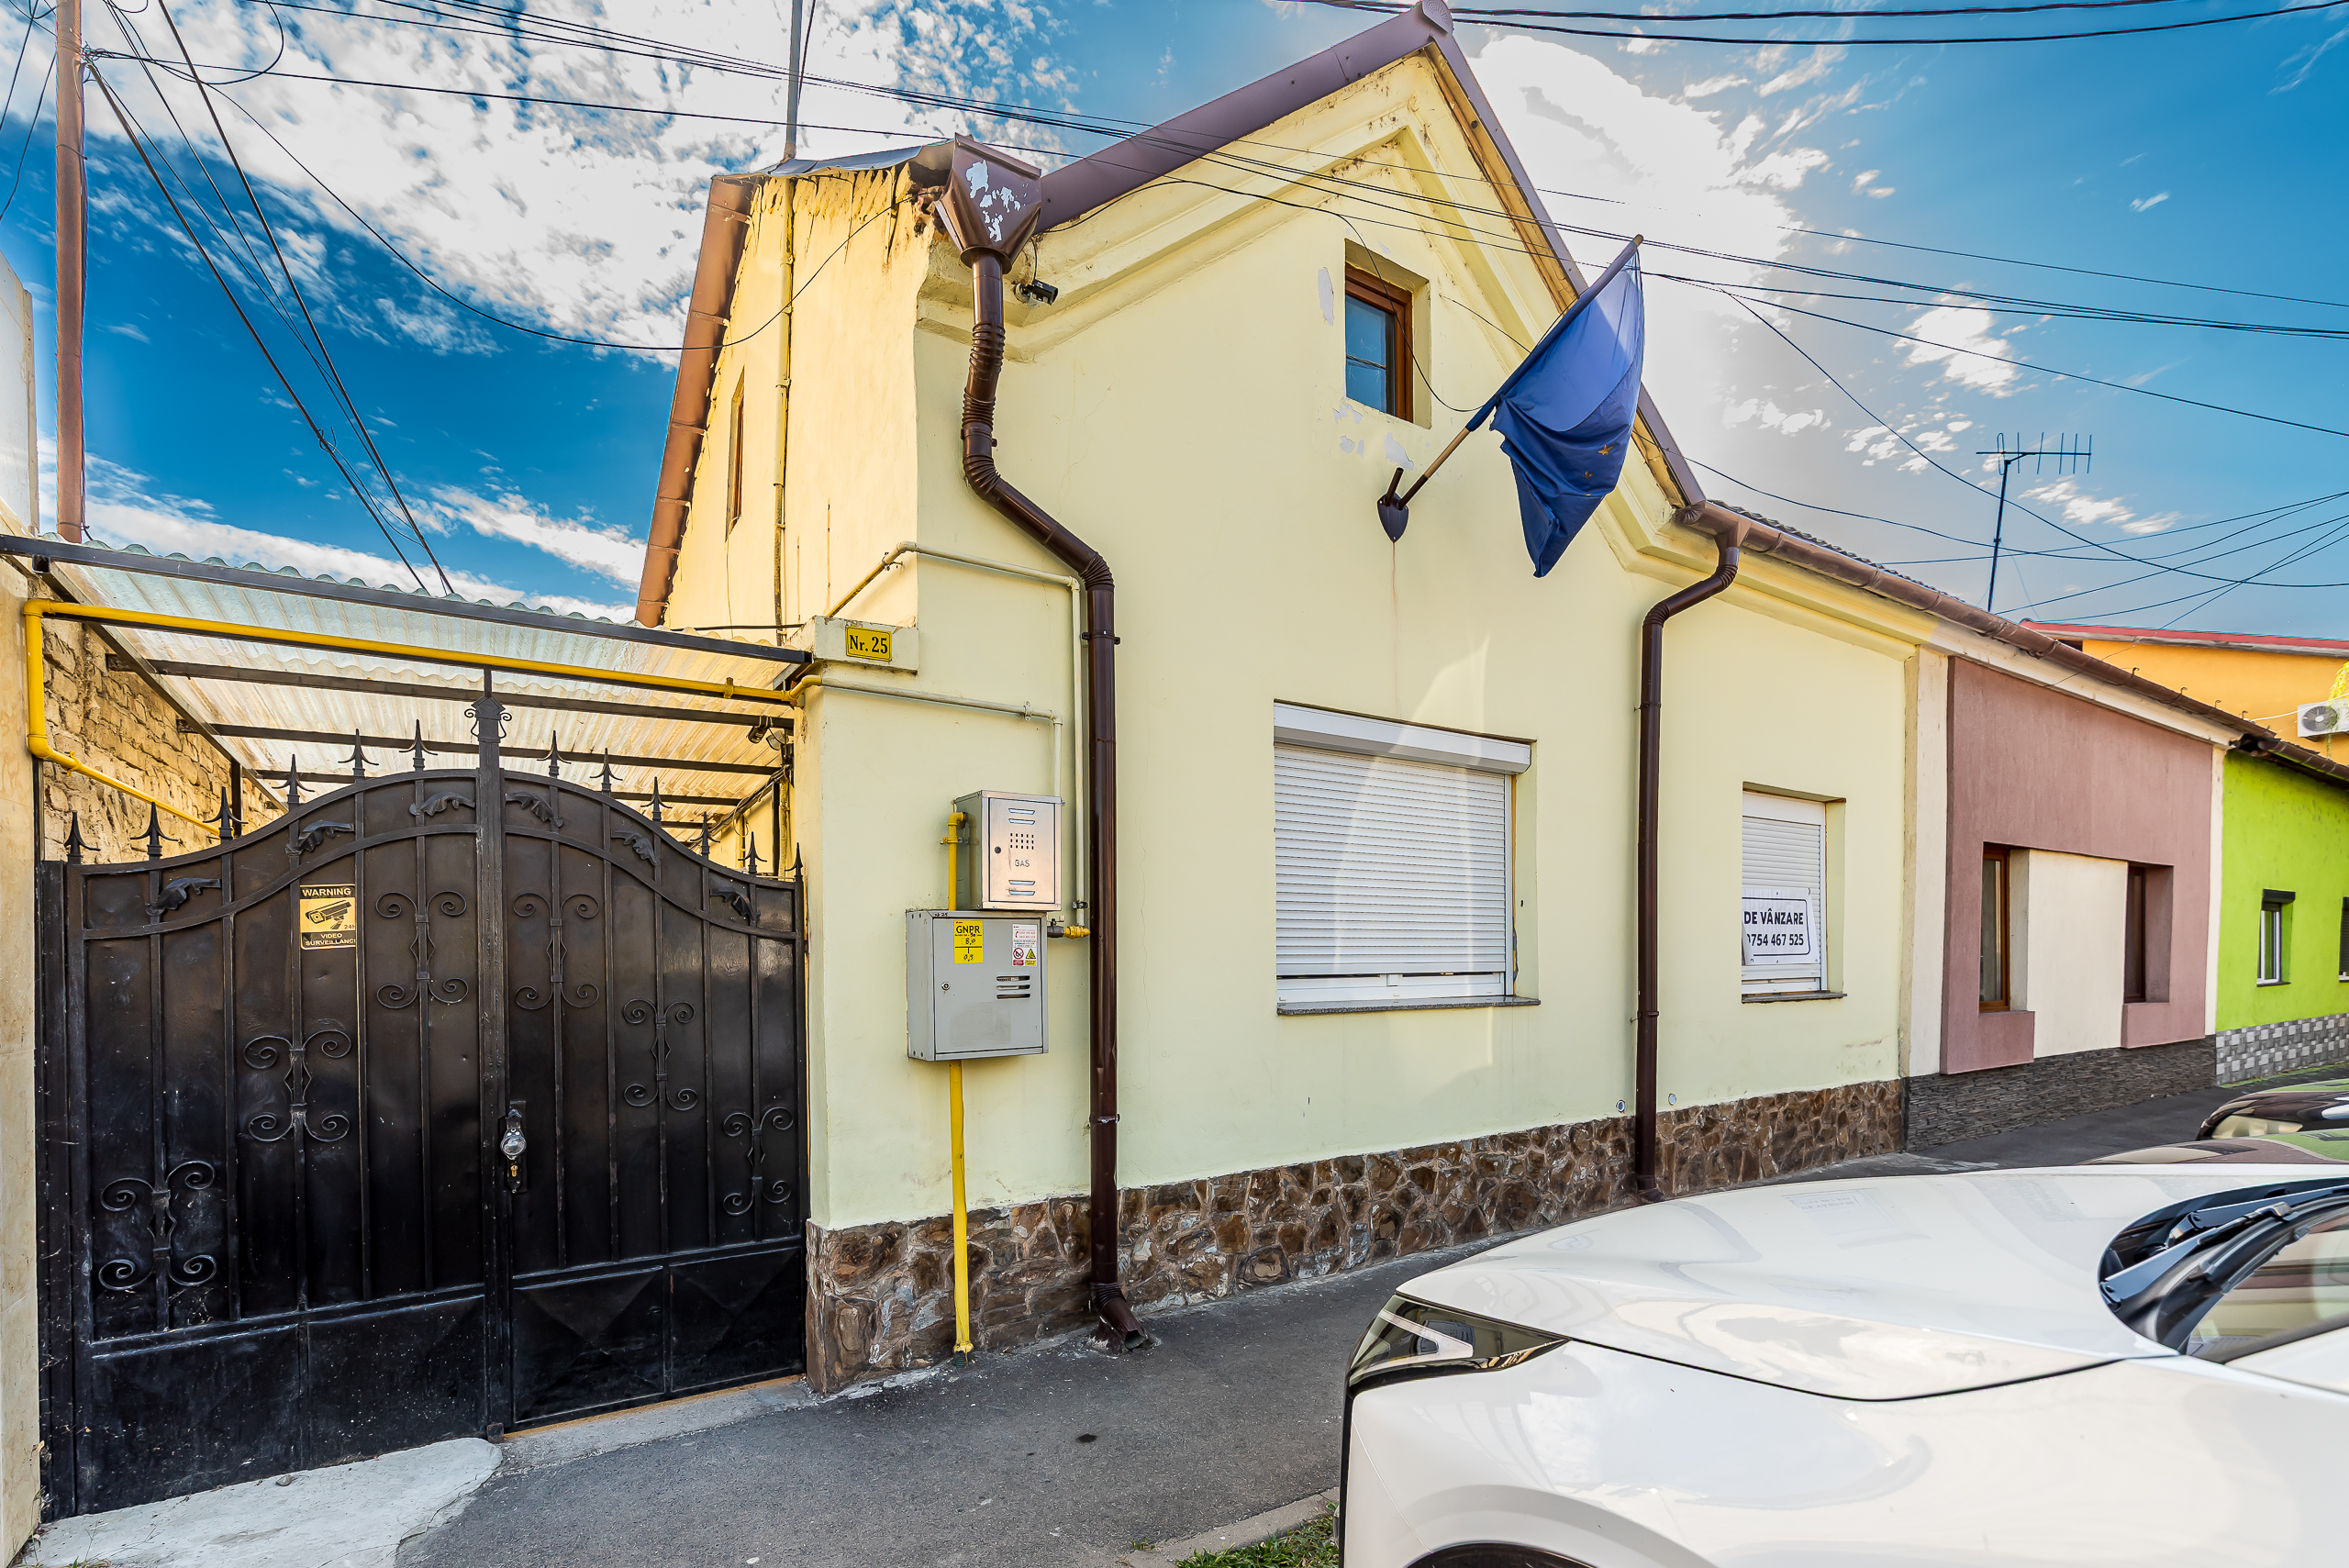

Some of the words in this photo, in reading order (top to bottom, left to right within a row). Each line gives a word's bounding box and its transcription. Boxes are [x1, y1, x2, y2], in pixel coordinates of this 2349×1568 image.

[849, 634, 868, 651] Nr.
[872, 636, 887, 653] 25
[1014, 859, 1030, 867] GAS
[302, 887, 351, 896] WARNING
[1743, 911, 1757, 924] DE
[1760, 907, 1803, 925] VÂNZARE
[955, 925, 980, 933] GNPR
[1771, 934, 1787, 946] 467
[1789, 934, 1804, 946] 525
